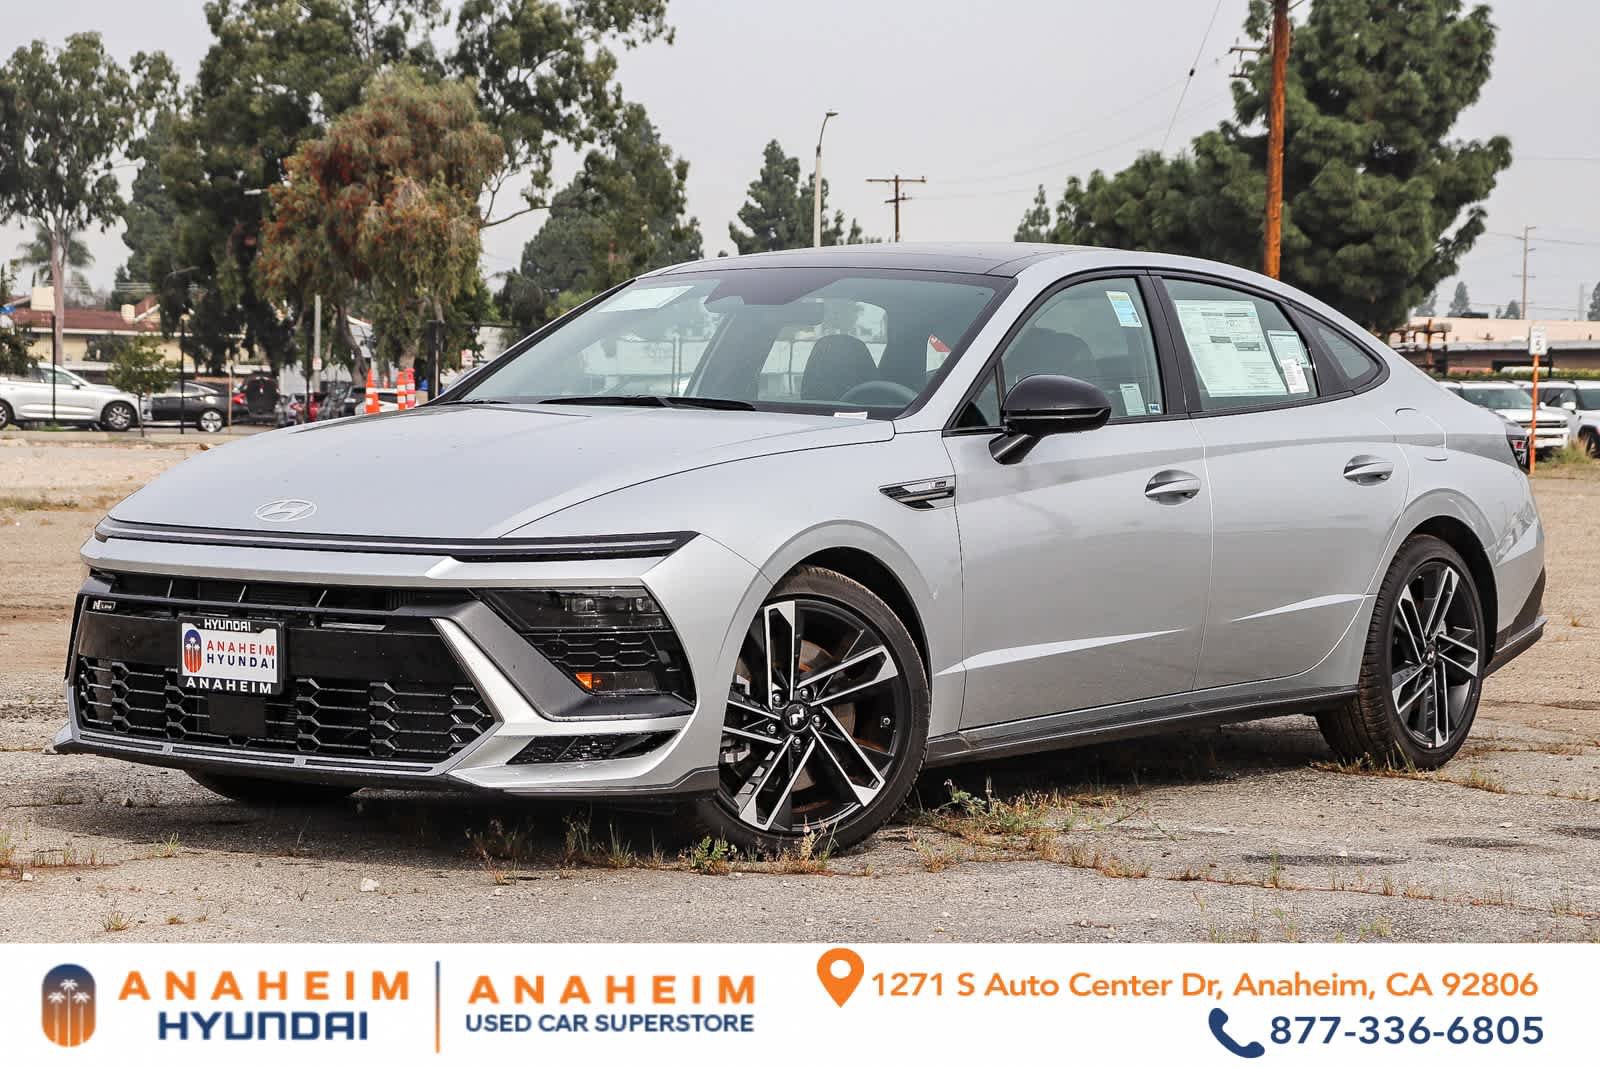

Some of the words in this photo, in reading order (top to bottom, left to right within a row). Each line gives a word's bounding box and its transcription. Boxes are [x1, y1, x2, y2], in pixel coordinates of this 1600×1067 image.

[204, 618, 251, 632] HYUNDAI
[206, 640, 275, 657] ANAHEIM
[206, 653, 275, 670] HYUNDAI
[186, 677, 272, 694] ANAHEIM
